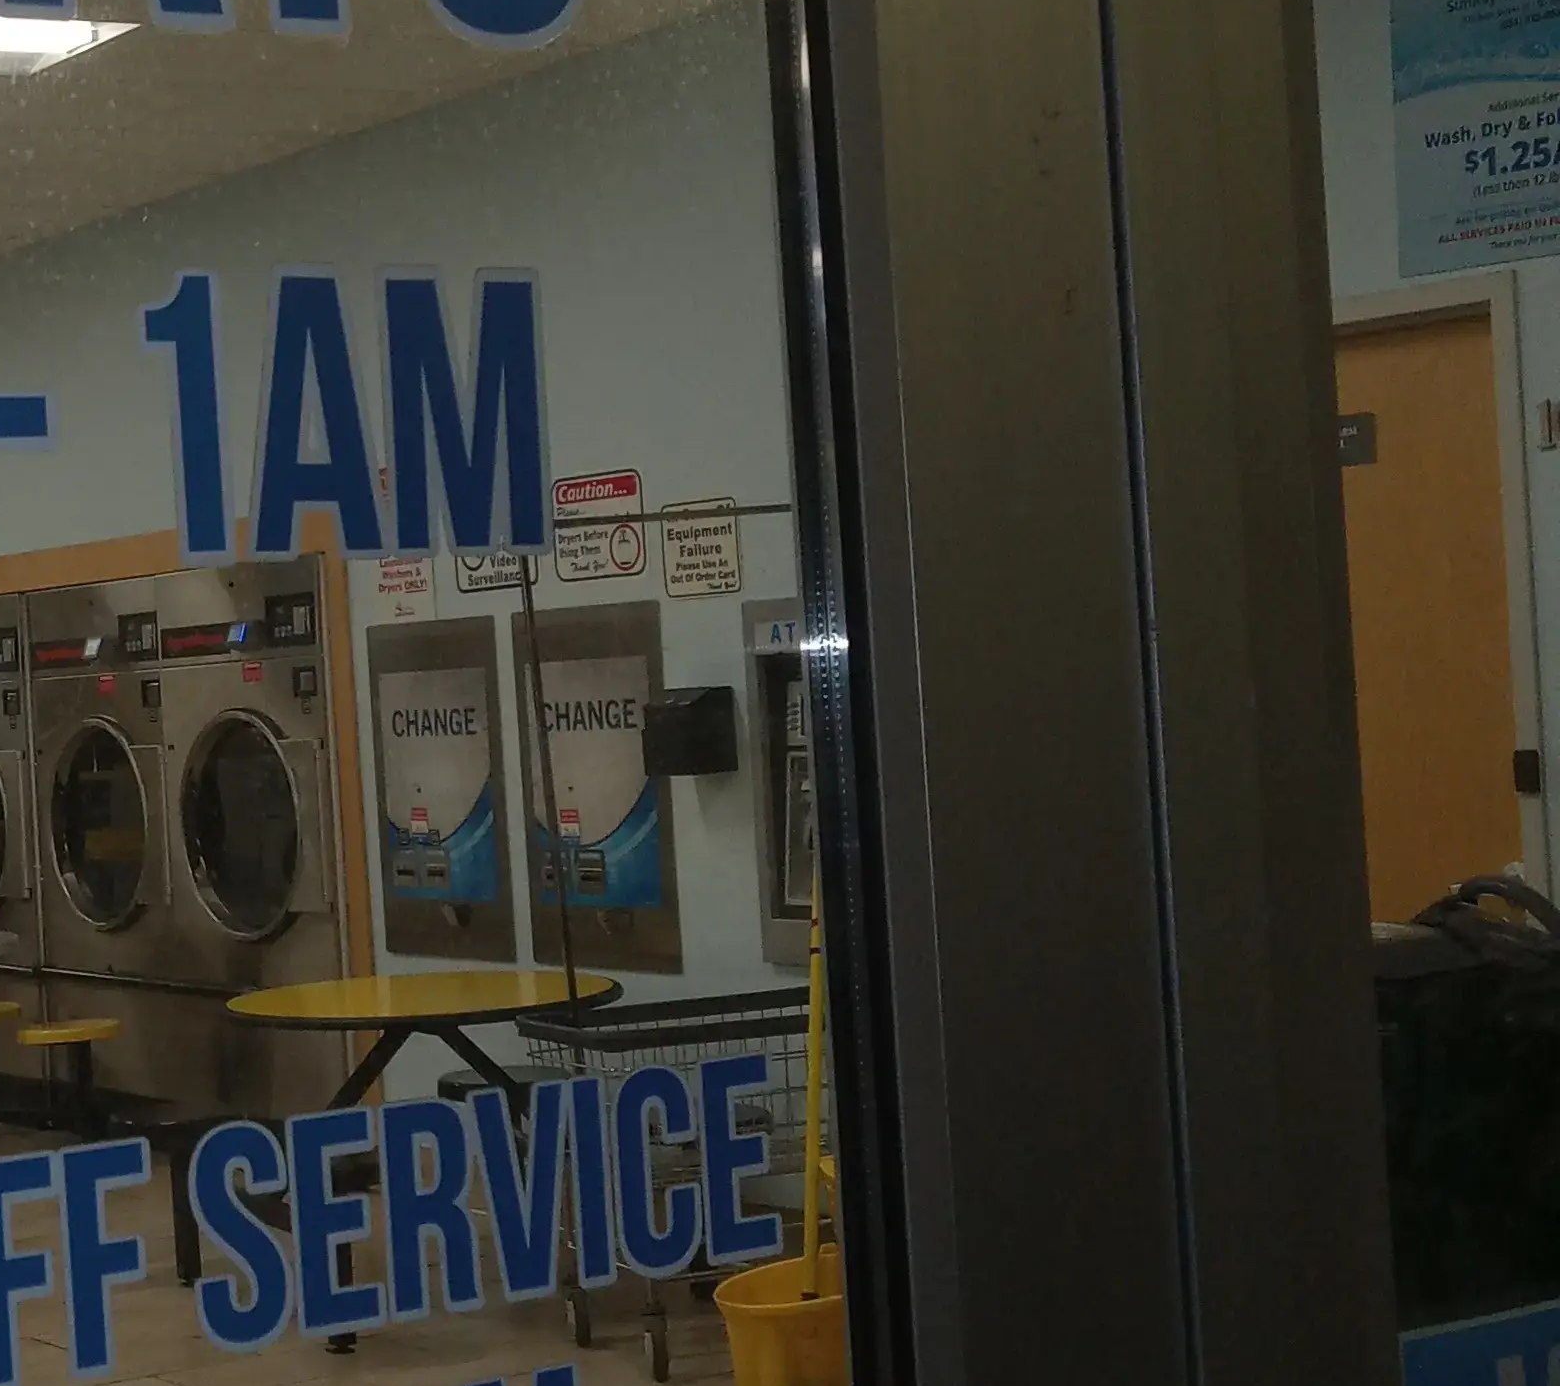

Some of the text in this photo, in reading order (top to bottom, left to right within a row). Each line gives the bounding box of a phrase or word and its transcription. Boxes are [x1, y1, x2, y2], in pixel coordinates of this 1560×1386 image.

[1424, 125, 1476, 149] Wash,
[1481, 120, 1513, 139] Dry
[1518, 116, 1531, 131] &
[141, 267, 549, 557] 1AM
[557, 481, 628, 503] Caution...
[666, 522, 733, 542] Equipment
[490, 555, 517, 569] Video
[679, 544, 722, 558] Failure
[467, 570, 523, 588] Surveillanc
[392, 707, 478, 738] CHANGE
[543, 699, 638, 732] CHANGE
[190, 1053, 782, 1348] SERVICE
